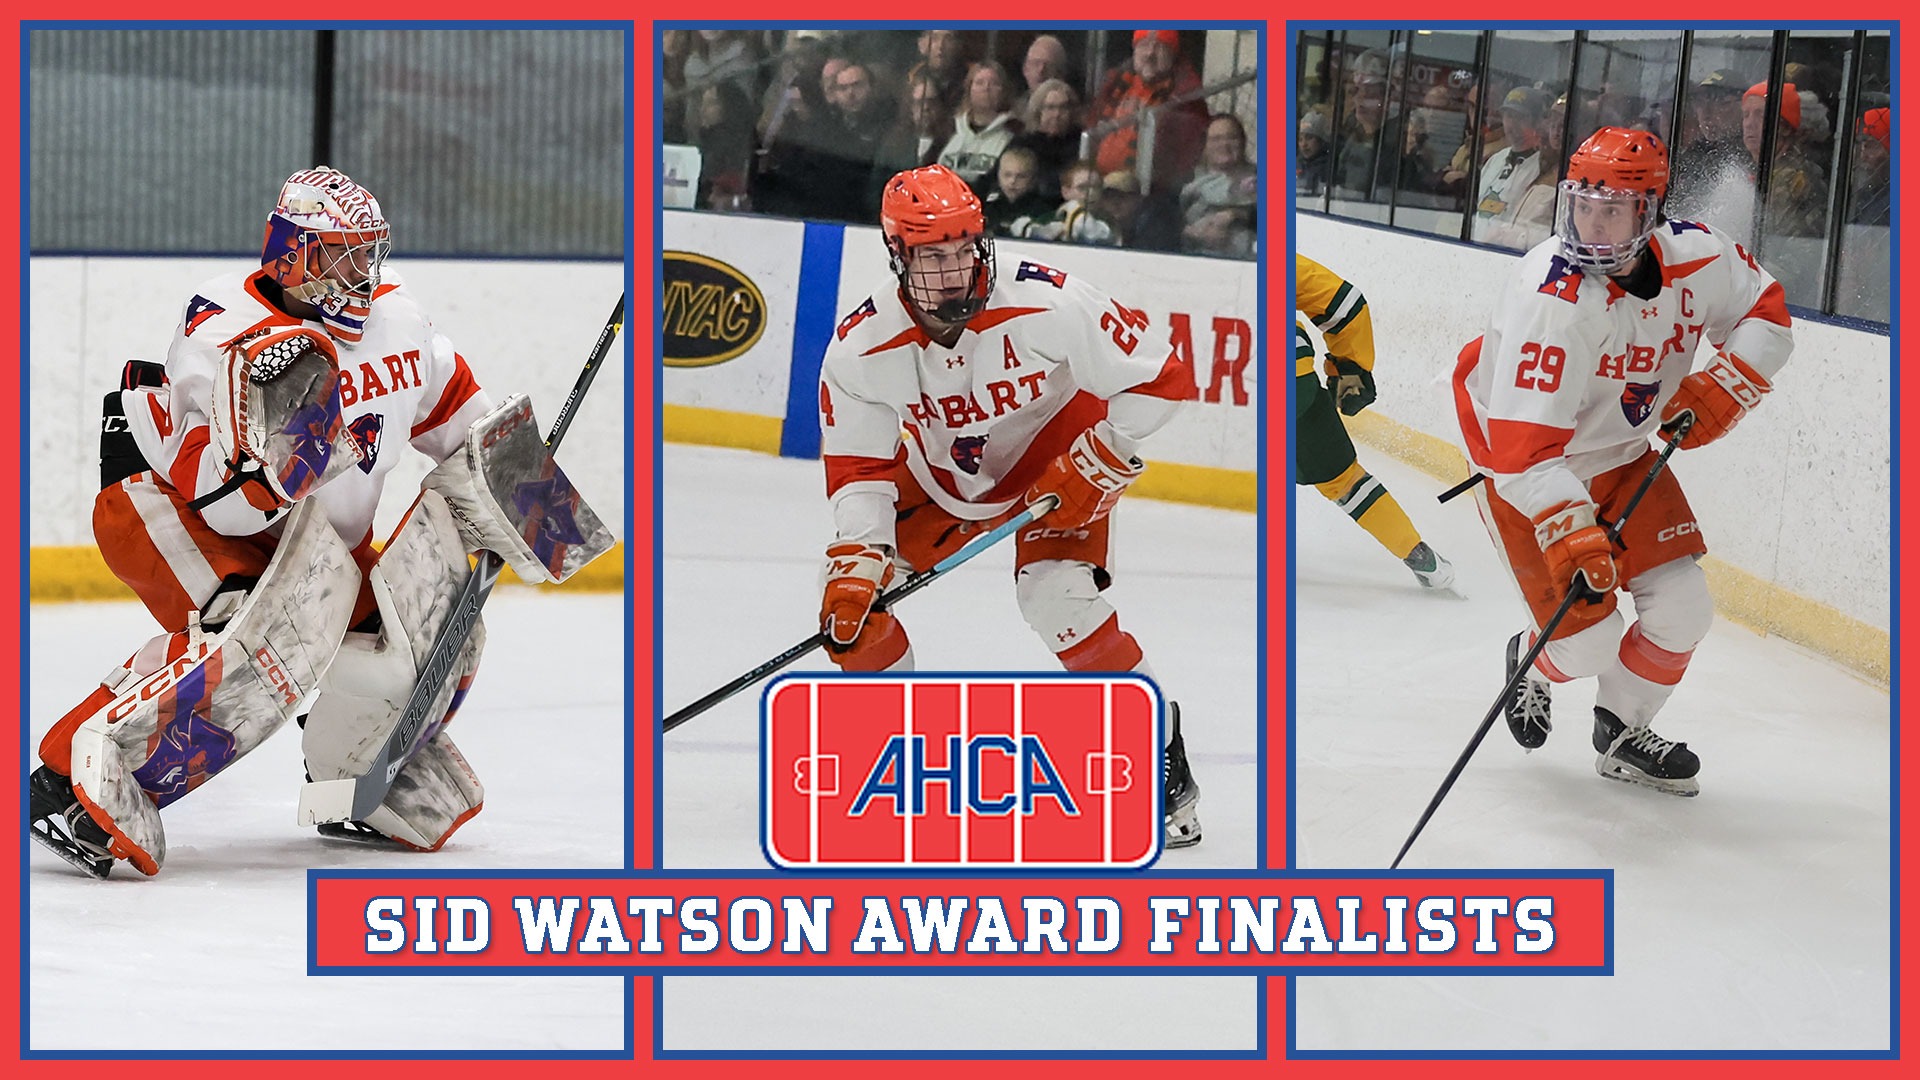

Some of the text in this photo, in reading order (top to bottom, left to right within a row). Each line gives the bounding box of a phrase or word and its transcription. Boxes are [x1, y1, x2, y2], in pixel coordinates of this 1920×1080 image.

[1681, 287, 1695, 318] C
[1514, 341, 1567, 394] 29
[255, 647, 298, 705] CCM
